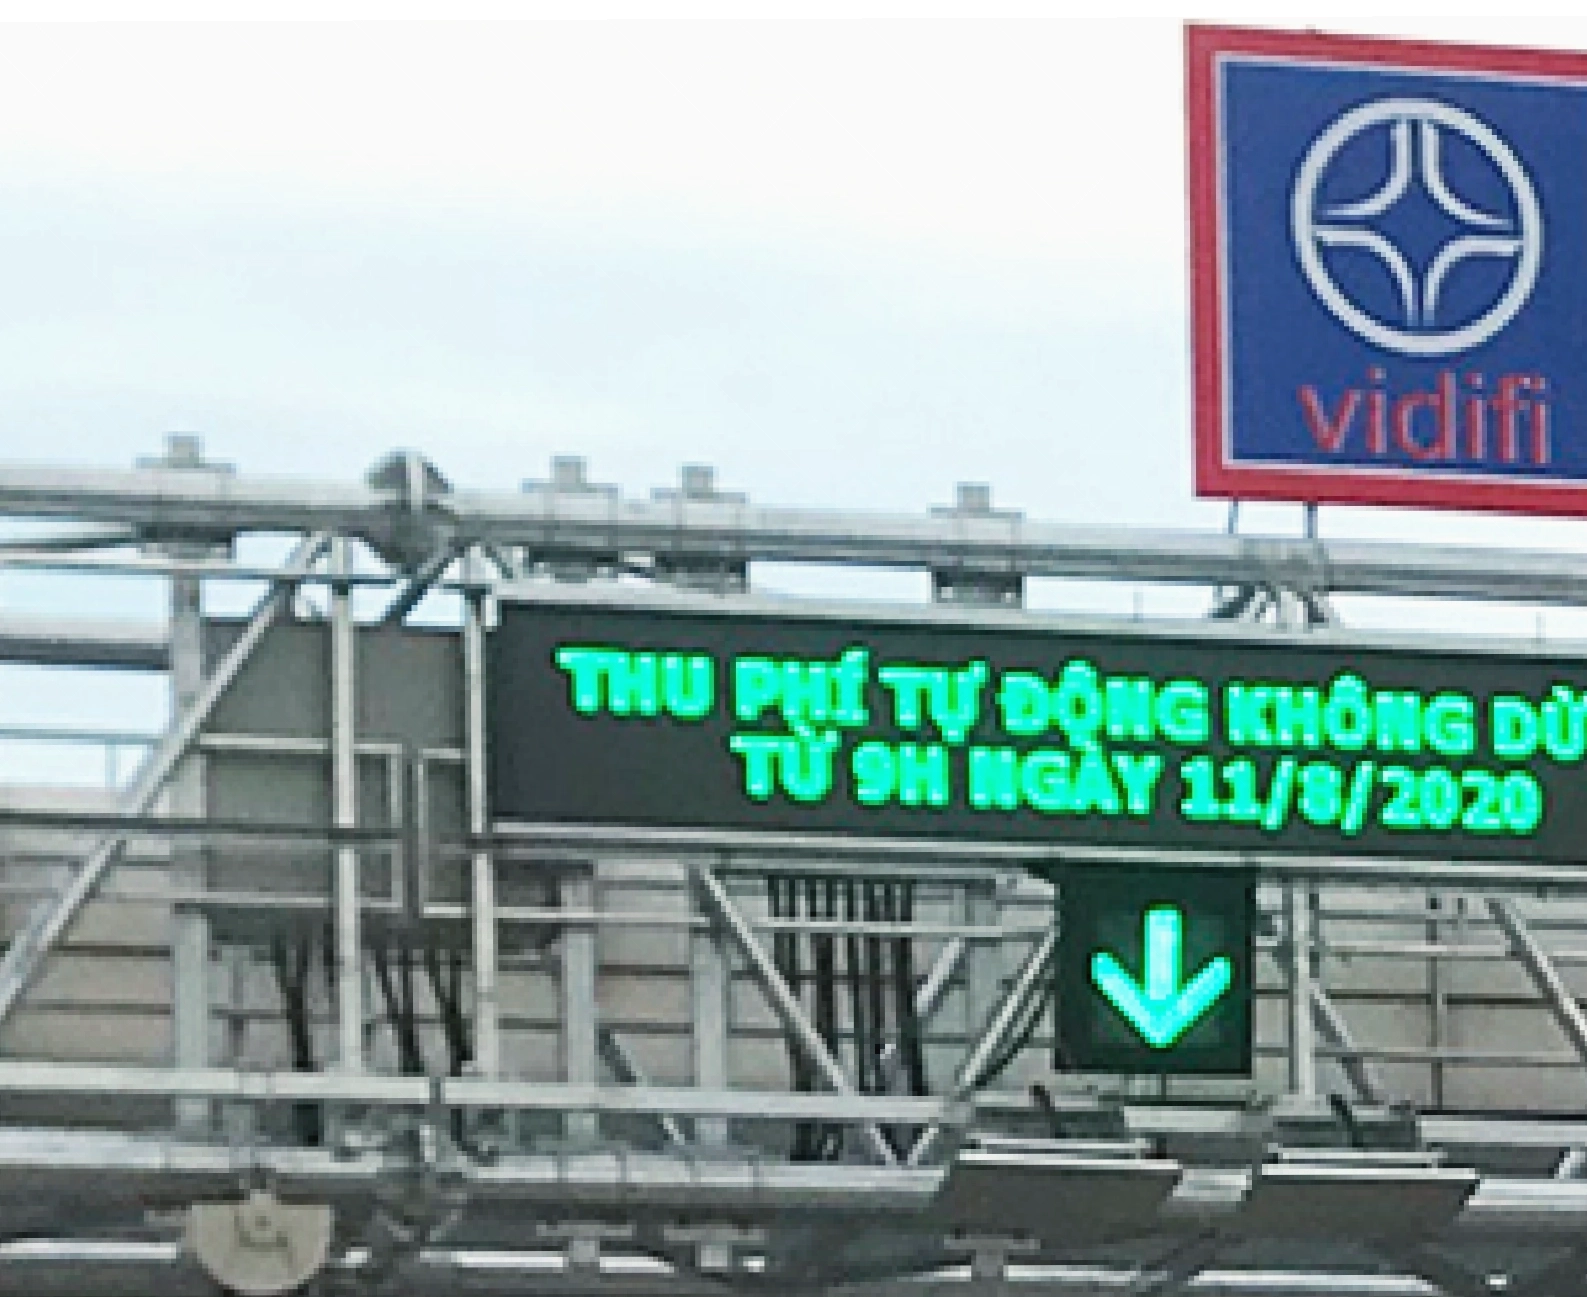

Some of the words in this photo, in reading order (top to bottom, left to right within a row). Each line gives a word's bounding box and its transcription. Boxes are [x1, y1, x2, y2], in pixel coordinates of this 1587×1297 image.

[1300, 367, 1554, 469] vidifi
[553, 645, 714, 722] THU
[733, 645, 869, 727] PHÍ
[878, 659, 991, 745] TỰ
[998, 659, 1209, 748] ĐỘNG
[1223, 669, 1475, 759] KHÔNG
[730, 729, 832, 800] TỪ
[854, 742, 946, 806] 9H
[967, 745, 1167, 817] NGÀY
